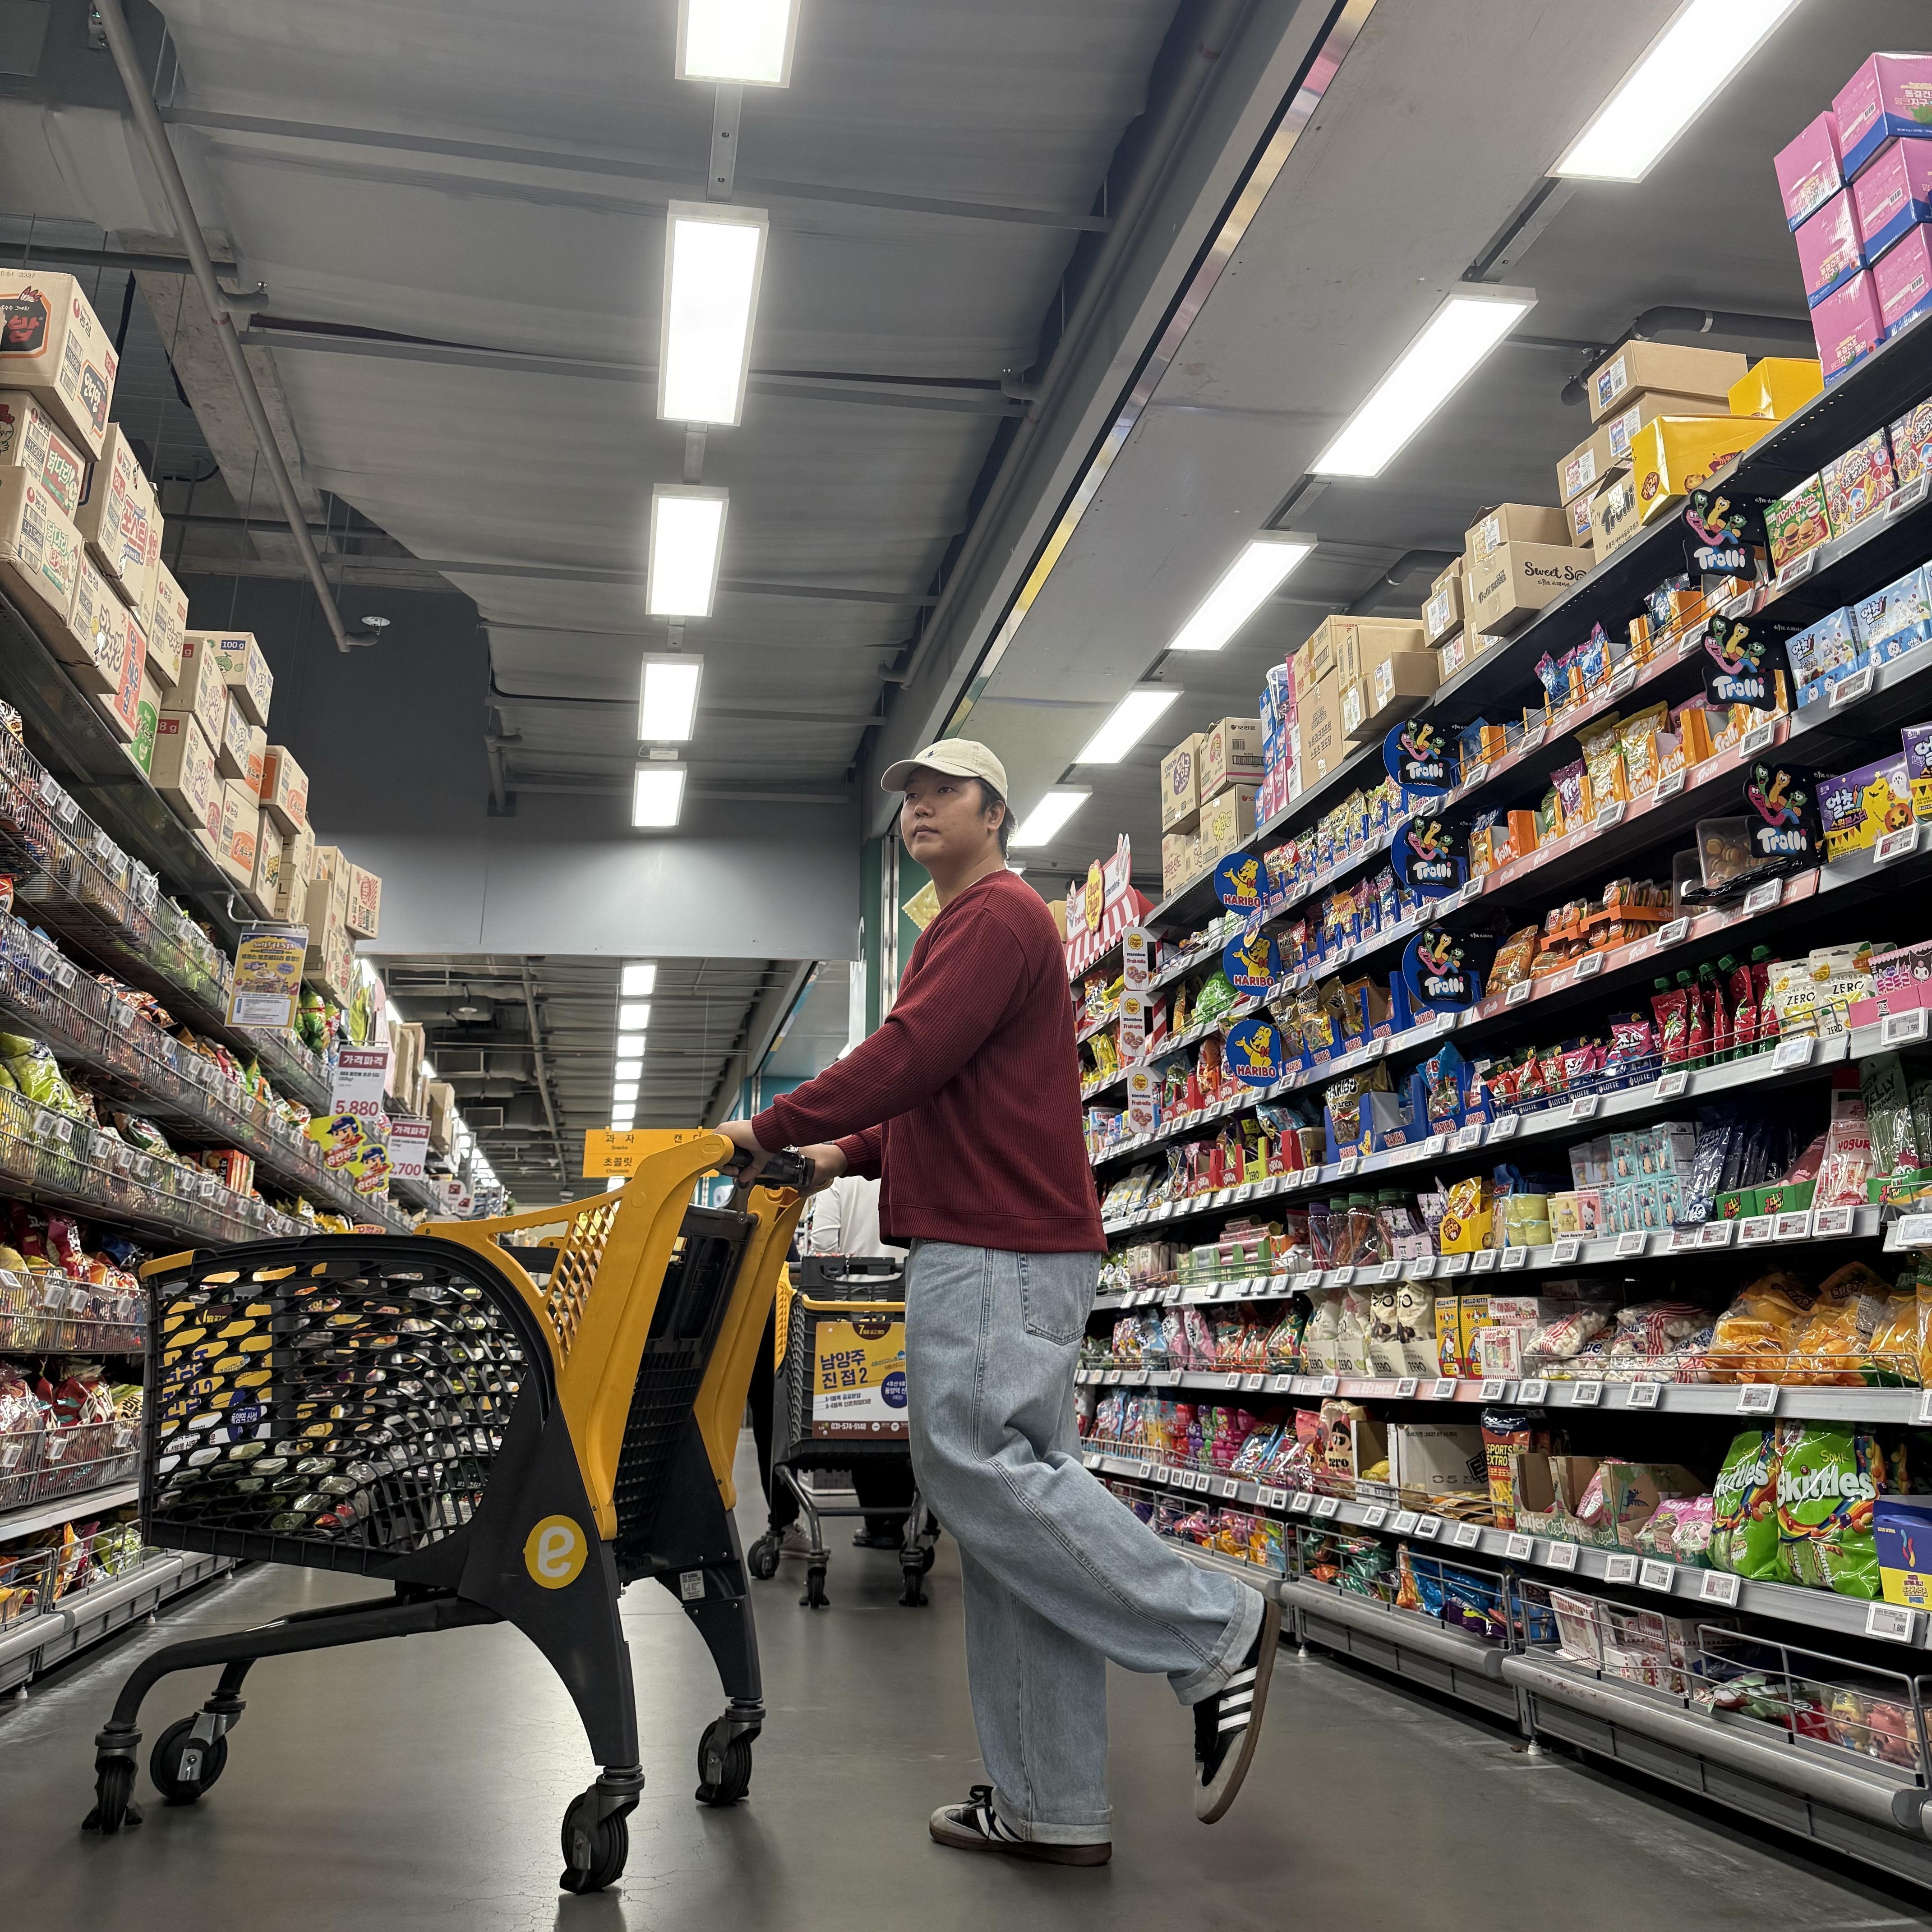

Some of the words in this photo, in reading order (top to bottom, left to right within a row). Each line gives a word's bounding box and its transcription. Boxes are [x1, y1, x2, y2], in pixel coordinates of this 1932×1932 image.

[1693, 547, 1746, 568] Trolli
[1524, 561, 1562, 580] Sweet
[1712, 676, 1765, 699] Trolli
[169, 723, 177, 733] g
[1405, 762, 1443, 781] Trolli
[1757, 827, 1807, 853] Trolli
[1412, 861, 1452, 880] Trolli
[1223, 893, 1261, 907] HARIBO
[1233, 975, 1275, 987] HARIBO
[1424, 976, 1464, 995] Trolli
[1833, 981, 1865, 995] ZERO
[1787, 992, 1816, 1006] ZERO
[1827, 1024, 1843, 1035] ZERO
[343, 1055, 383, 1066] 가격파격
[1236, 1064, 1277, 1078] HARIBO
[393, 1125, 427, 1136] 가격파격
[820, 1349, 866, 1371] 남양주
[1309, 1358, 1323, 1370] ZERO
[1338, 1359, 1353, 1371] ZERO
[1374, 1362, 1392, 1373] ZERO
[1407, 1362, 1426, 1373] ZERO
[1486, 1443, 1513, 1455] SPORTS
[1820, 1449, 1850, 1465] SOUR
[1776, 1471, 1877, 1509] Skittles
[1515, 1512, 1546, 1530] Katjes
[537, 1526, 575, 1578] e
